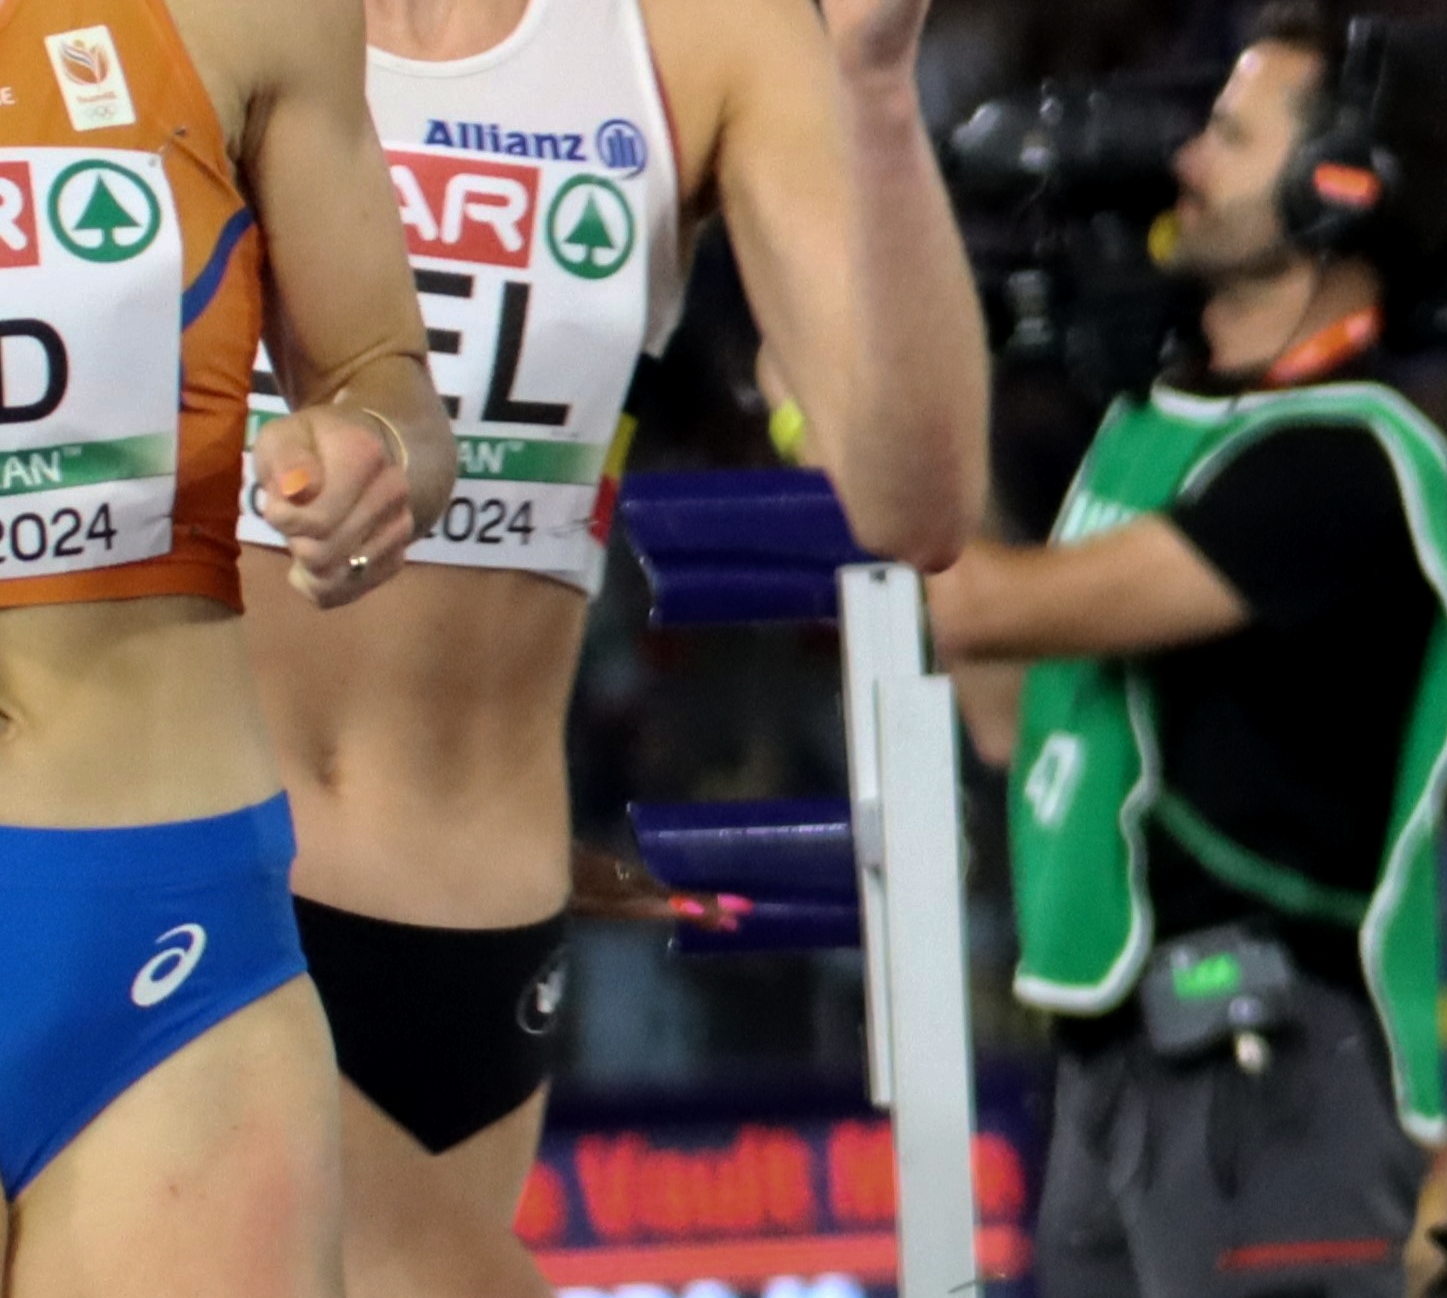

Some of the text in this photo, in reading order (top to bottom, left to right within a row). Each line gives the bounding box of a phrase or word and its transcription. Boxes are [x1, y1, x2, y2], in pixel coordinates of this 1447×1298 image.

[424, 118, 587, 162] Allianz
[390, 164, 528, 253] AR
[412, 268, 570, 426] EL
[424, 497, 536, 546] 024
